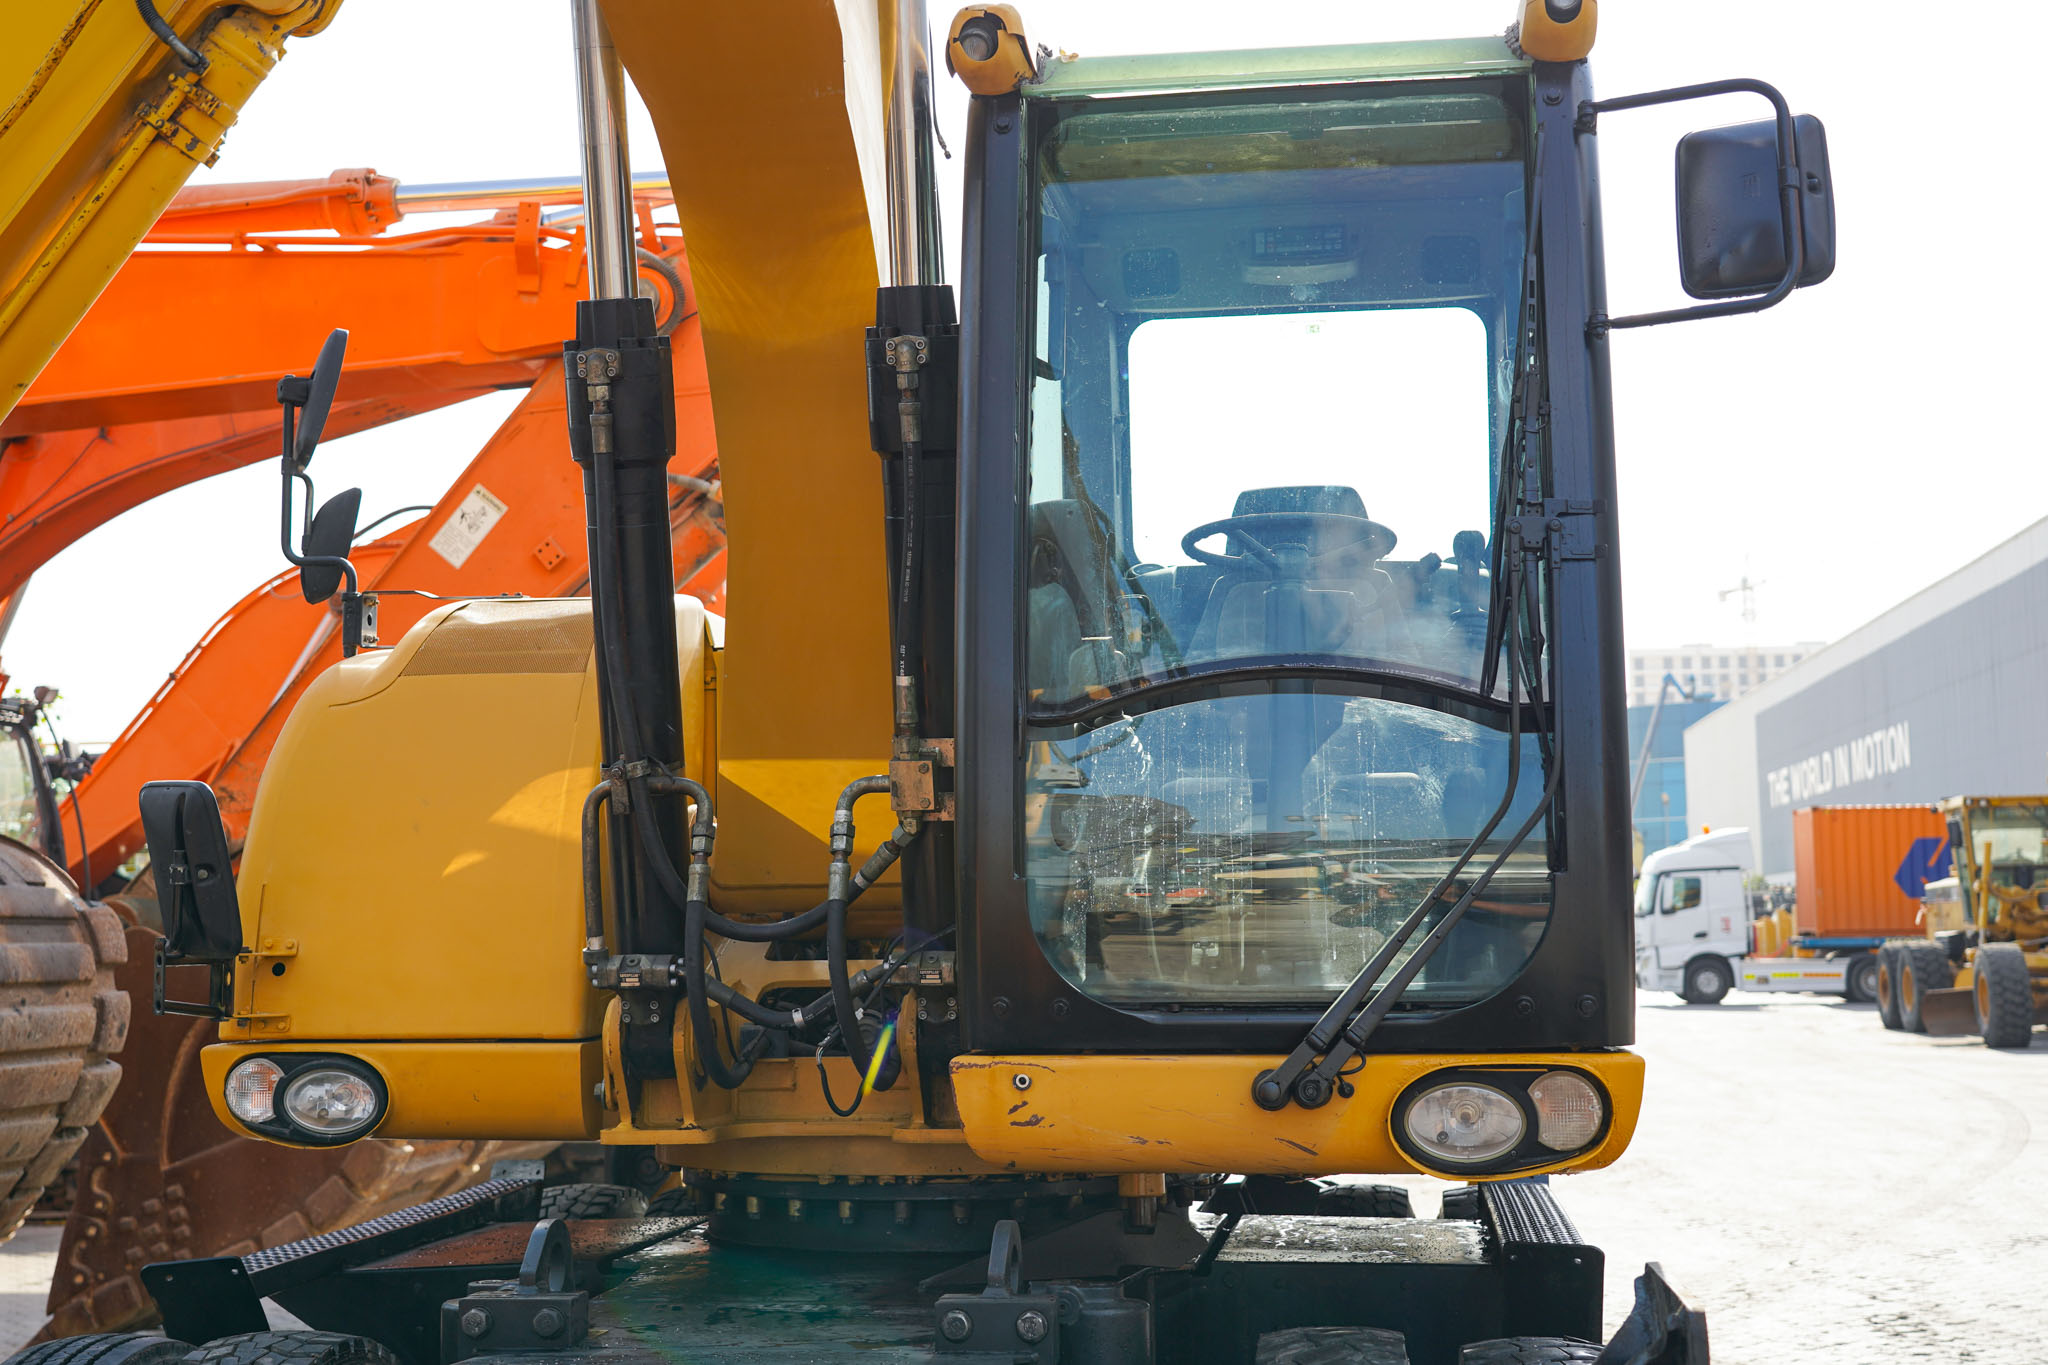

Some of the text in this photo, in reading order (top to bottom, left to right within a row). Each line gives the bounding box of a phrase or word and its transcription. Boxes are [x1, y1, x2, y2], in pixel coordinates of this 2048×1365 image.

[1767, 720, 1911, 809] THE WORLD IN MOTION
